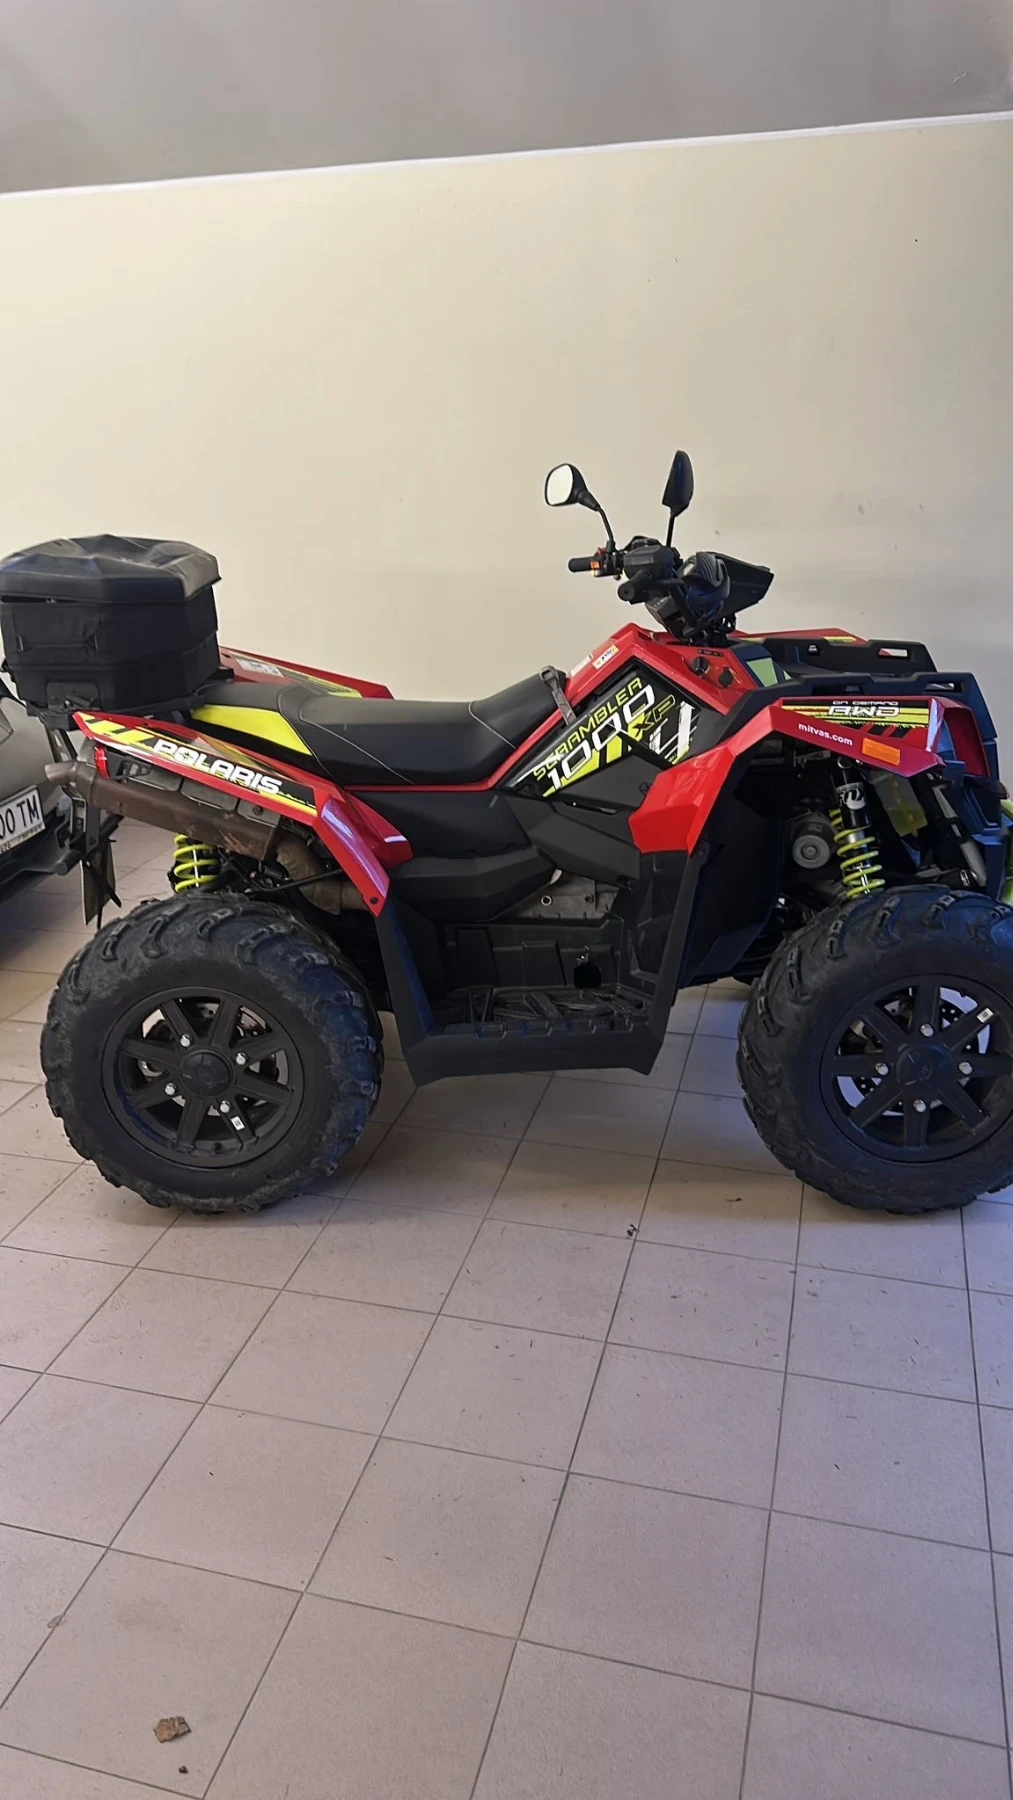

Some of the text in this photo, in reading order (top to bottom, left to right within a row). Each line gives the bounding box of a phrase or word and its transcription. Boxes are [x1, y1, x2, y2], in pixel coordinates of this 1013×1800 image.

[533, 678, 642, 781] SCRAMBLER
[798, 723, 853, 745] mitvas.com
[828, 706, 900, 717] AWD
[547, 684, 676, 790] 1000 XP
[152, 738, 282, 795] POLARIS
[16, 795, 40, 828] TM
